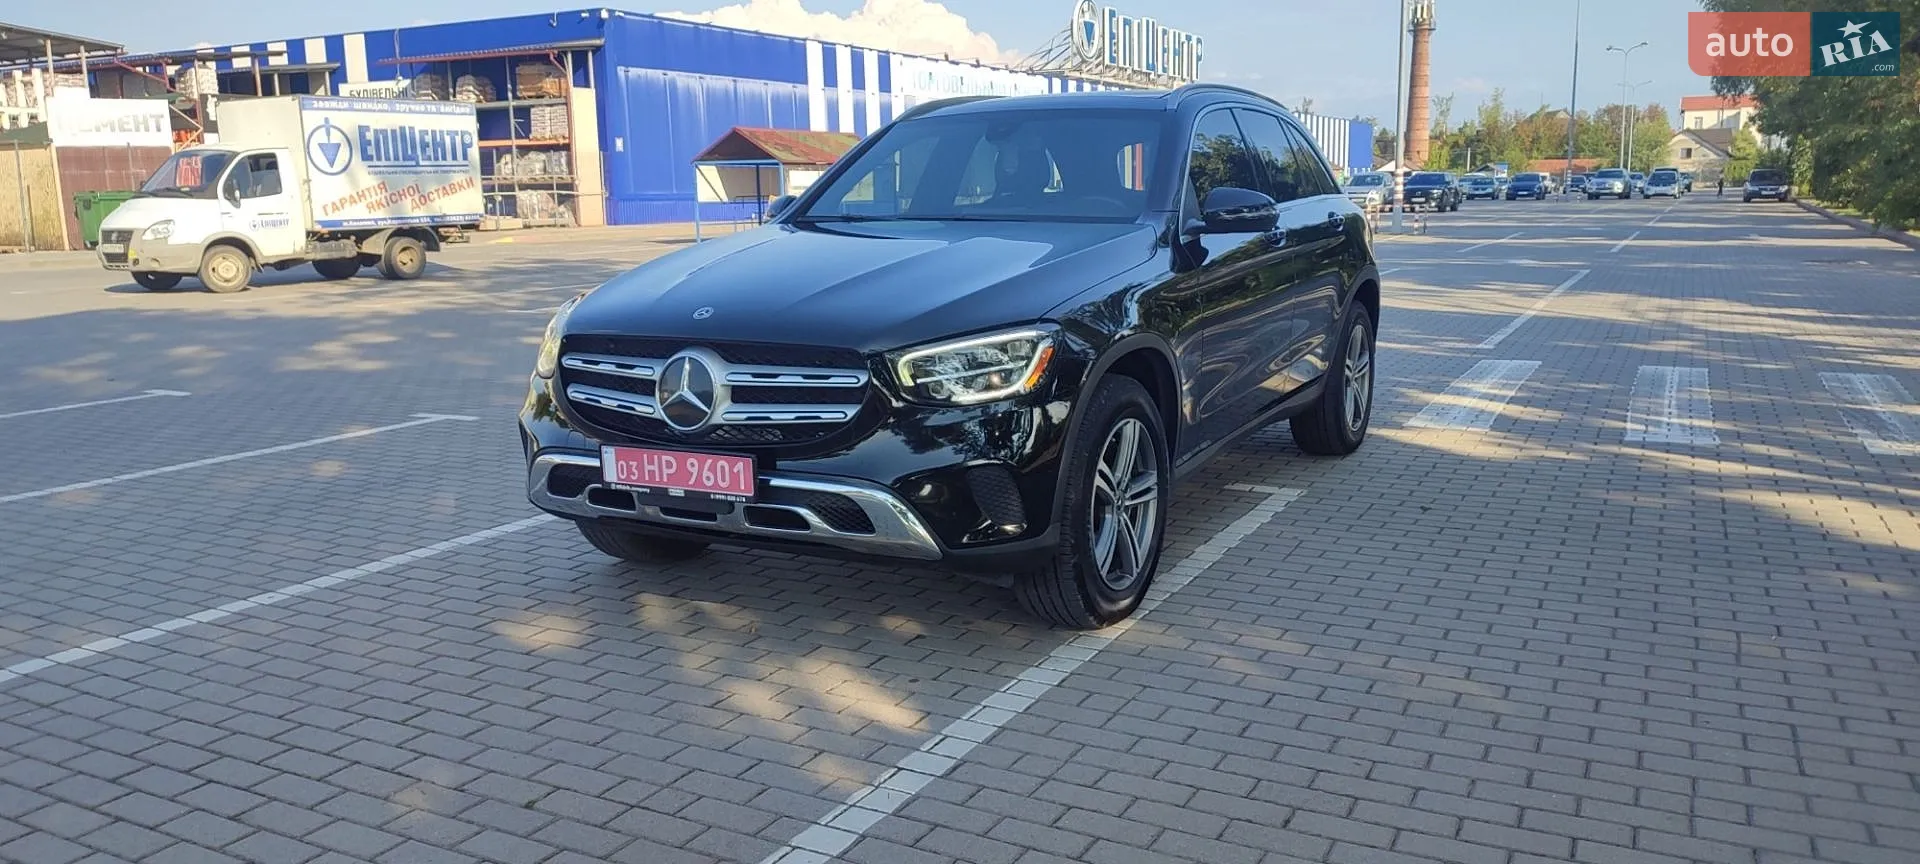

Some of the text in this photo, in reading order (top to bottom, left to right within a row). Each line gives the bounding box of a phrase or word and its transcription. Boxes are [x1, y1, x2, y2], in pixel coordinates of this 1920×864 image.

[1103, 6, 1204, 81] ЕПІЦЕНТР
[357, 124, 473, 167] ЕПІЦЕНТР
[322, 181, 389, 216] ГАРАНТІЯ
[365, 183, 421, 214] ЯКІСНОЇ
[410, 176, 475, 213] ДОСТАВКИ
[617, 453, 746, 490] 03 HP 9601
